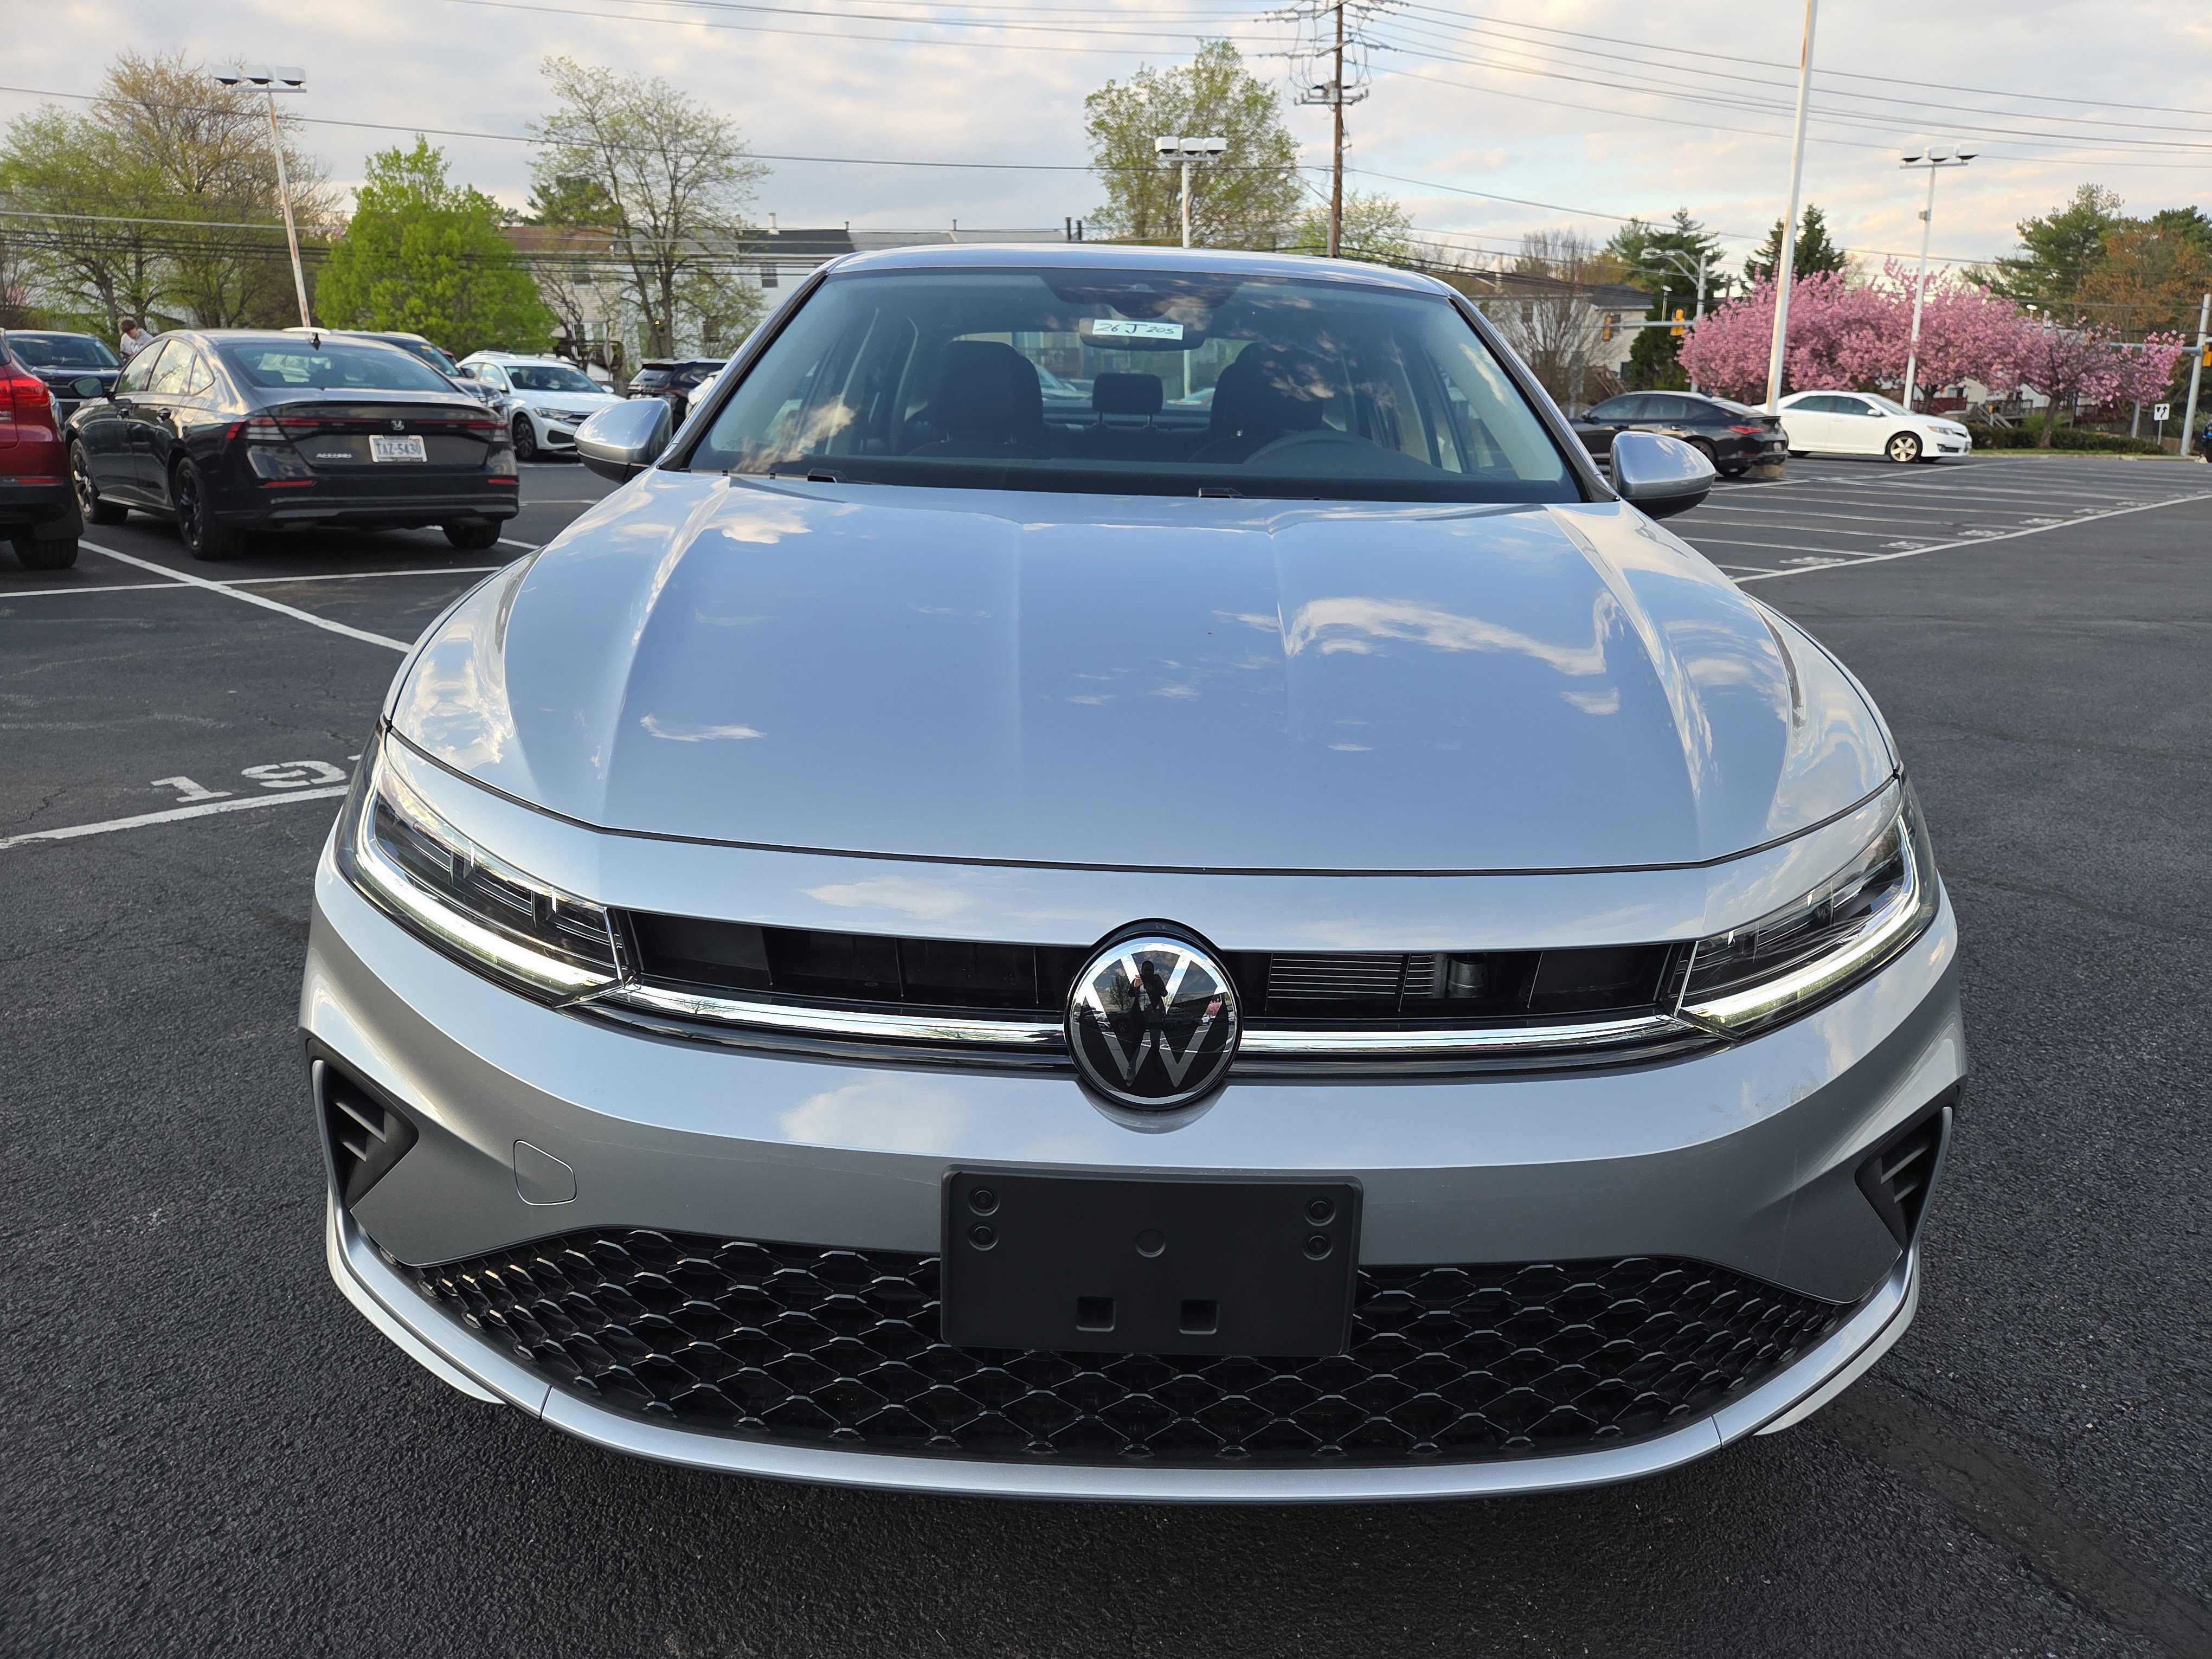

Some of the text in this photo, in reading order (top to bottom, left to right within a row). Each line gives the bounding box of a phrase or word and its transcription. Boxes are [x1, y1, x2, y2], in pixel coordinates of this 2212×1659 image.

[1094, 323, 1181, 335] 26 J 205
[150, 754, 361, 803] 19
